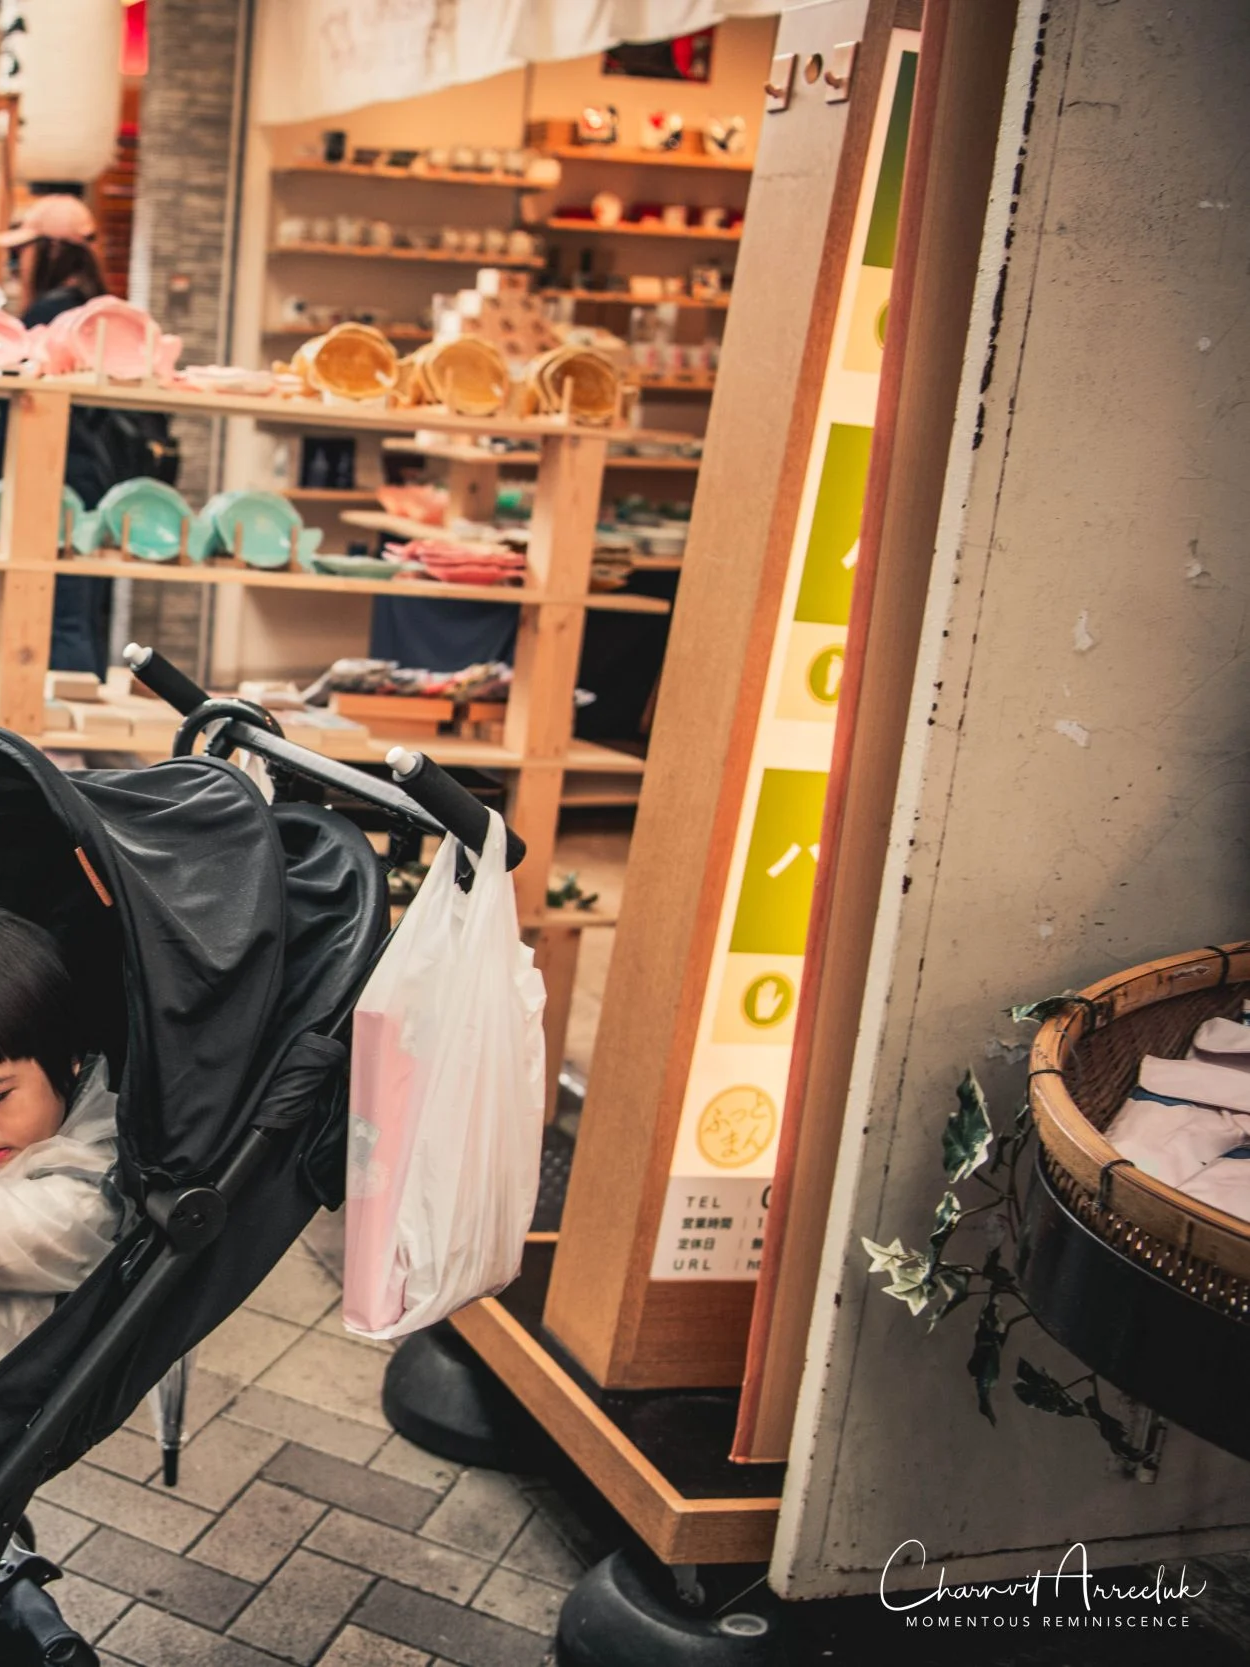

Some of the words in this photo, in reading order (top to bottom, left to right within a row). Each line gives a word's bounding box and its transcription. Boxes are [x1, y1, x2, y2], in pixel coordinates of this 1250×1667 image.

[686, 1195, 721, 1208] TEL
[677, 1237, 716, 1251] 定休日
[672, 1258, 712, 1271] URL
